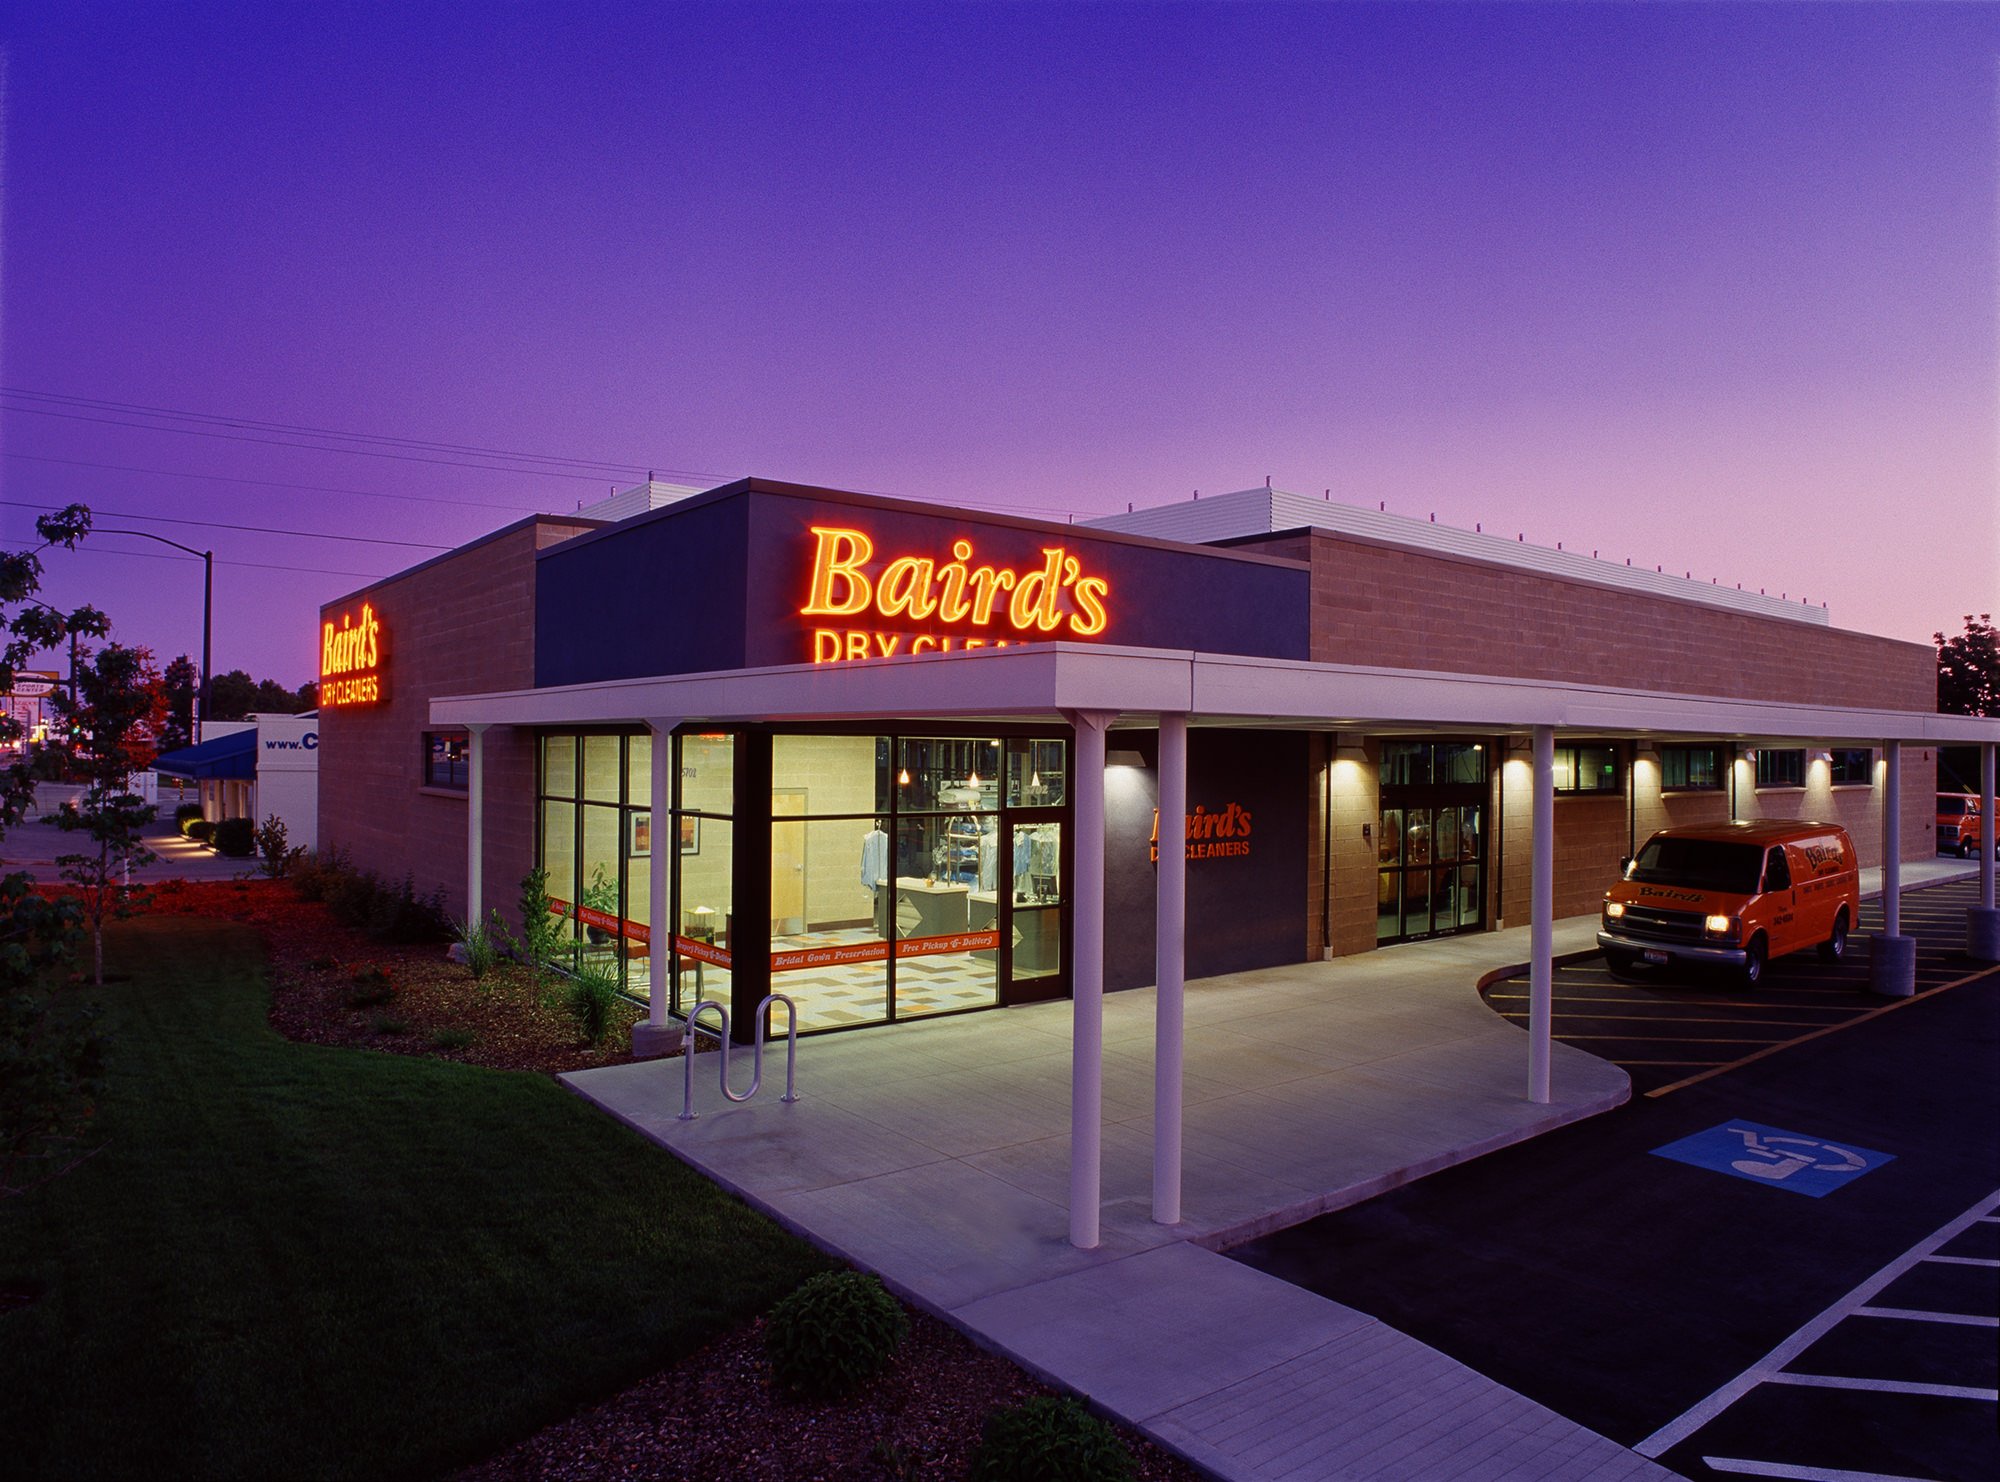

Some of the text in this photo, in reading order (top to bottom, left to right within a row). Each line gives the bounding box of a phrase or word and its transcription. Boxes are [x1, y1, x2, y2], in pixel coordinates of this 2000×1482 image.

[800, 527, 1107, 634] Baird's
[322, 603, 378, 676] Baird's
[322, 675, 378, 706] DRY CLEANERS
[775, 947, 886, 967] Bridal Gown Preservation
[902, 936, 993, 953] Free Pickup & Delivery
